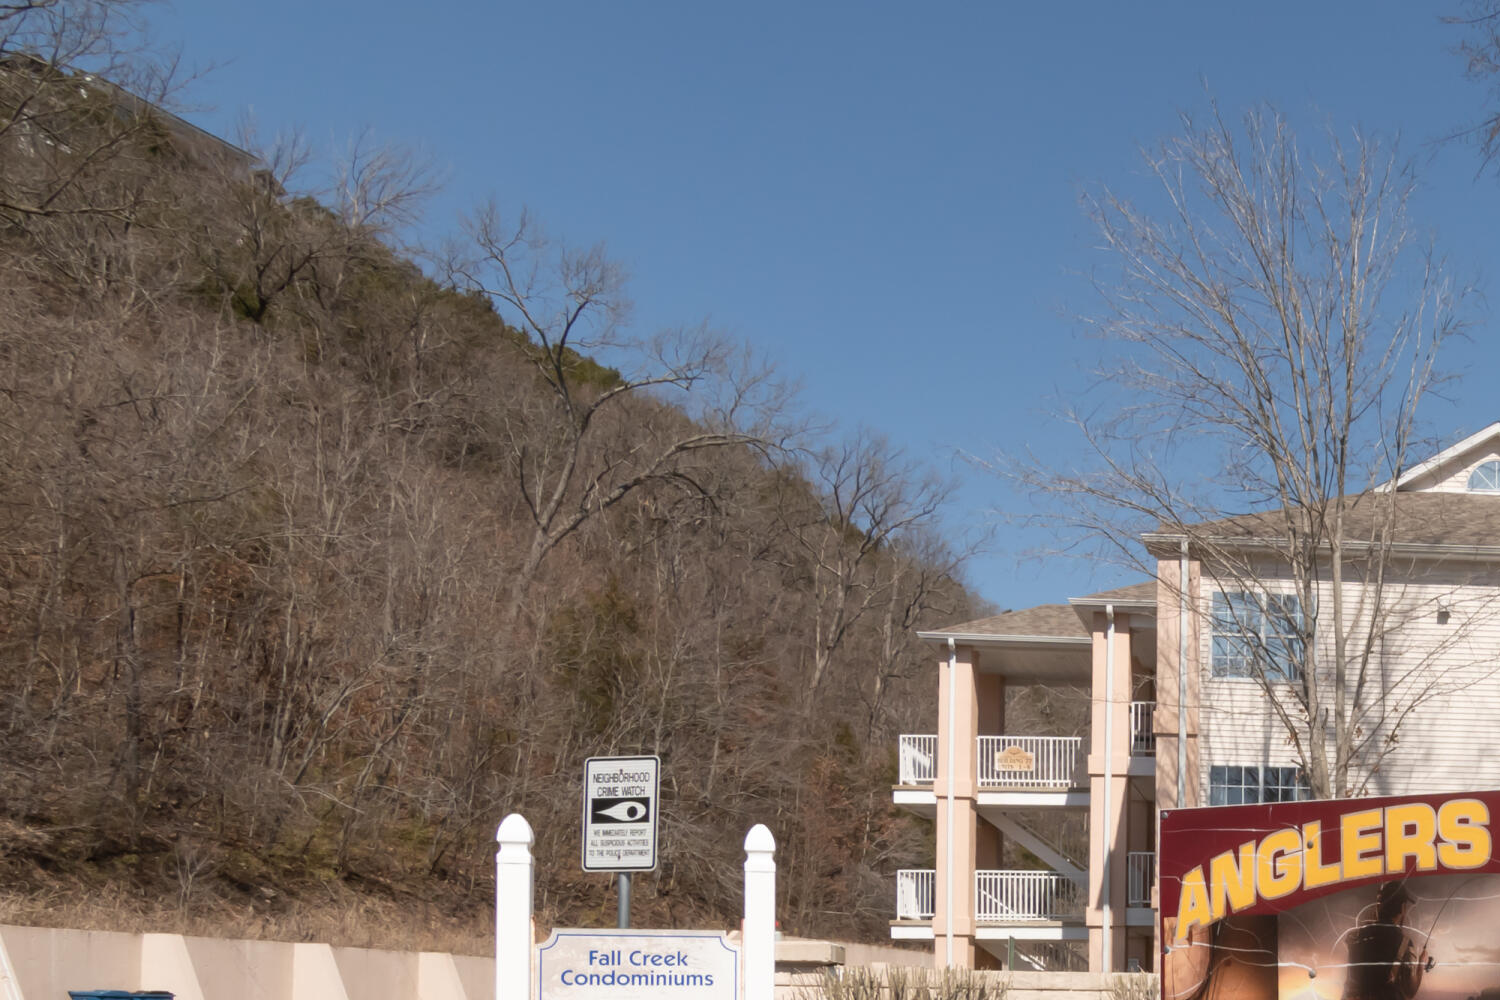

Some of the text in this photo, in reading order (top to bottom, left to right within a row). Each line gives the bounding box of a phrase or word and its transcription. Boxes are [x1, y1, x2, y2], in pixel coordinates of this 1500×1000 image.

[592, 772, 650, 783] NEIGHBORHOOD
[597, 786, 646, 797] CRIME WATCH
[1173, 798, 1493, 948] ANGLERS
[588, 950, 689, 967] Fall Creek
[560, 969, 714, 986] Condominiums
